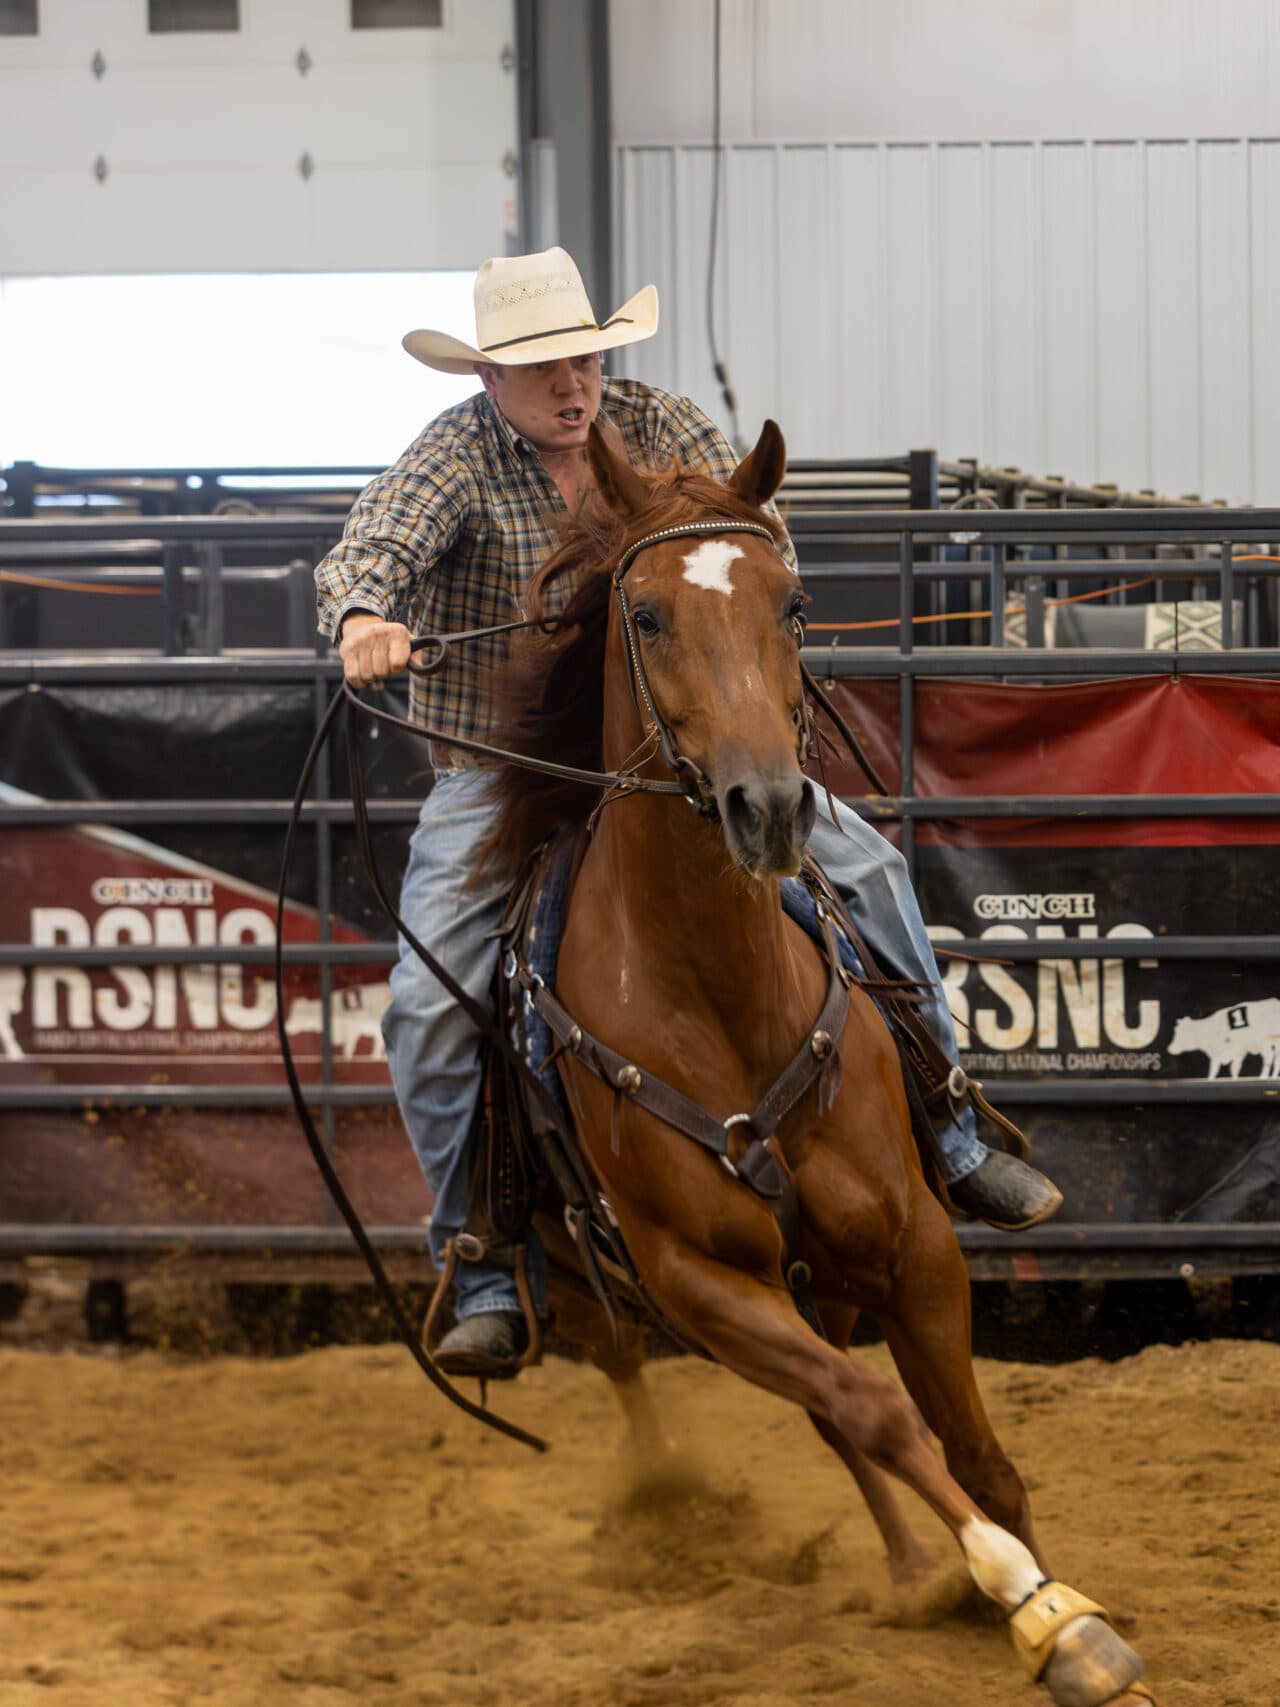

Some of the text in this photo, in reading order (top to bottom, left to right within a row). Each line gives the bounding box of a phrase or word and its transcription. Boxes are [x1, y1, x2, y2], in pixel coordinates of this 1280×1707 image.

[92, 877, 214, 905] CINCH
[973, 893, 1096, 919] CINCH
[31, 907, 278, 1031] RSNC
[1006, 1053, 1064, 1071] NATIONAL
[1066, 1053, 1161, 1071] CHAMPIONSHIPS
